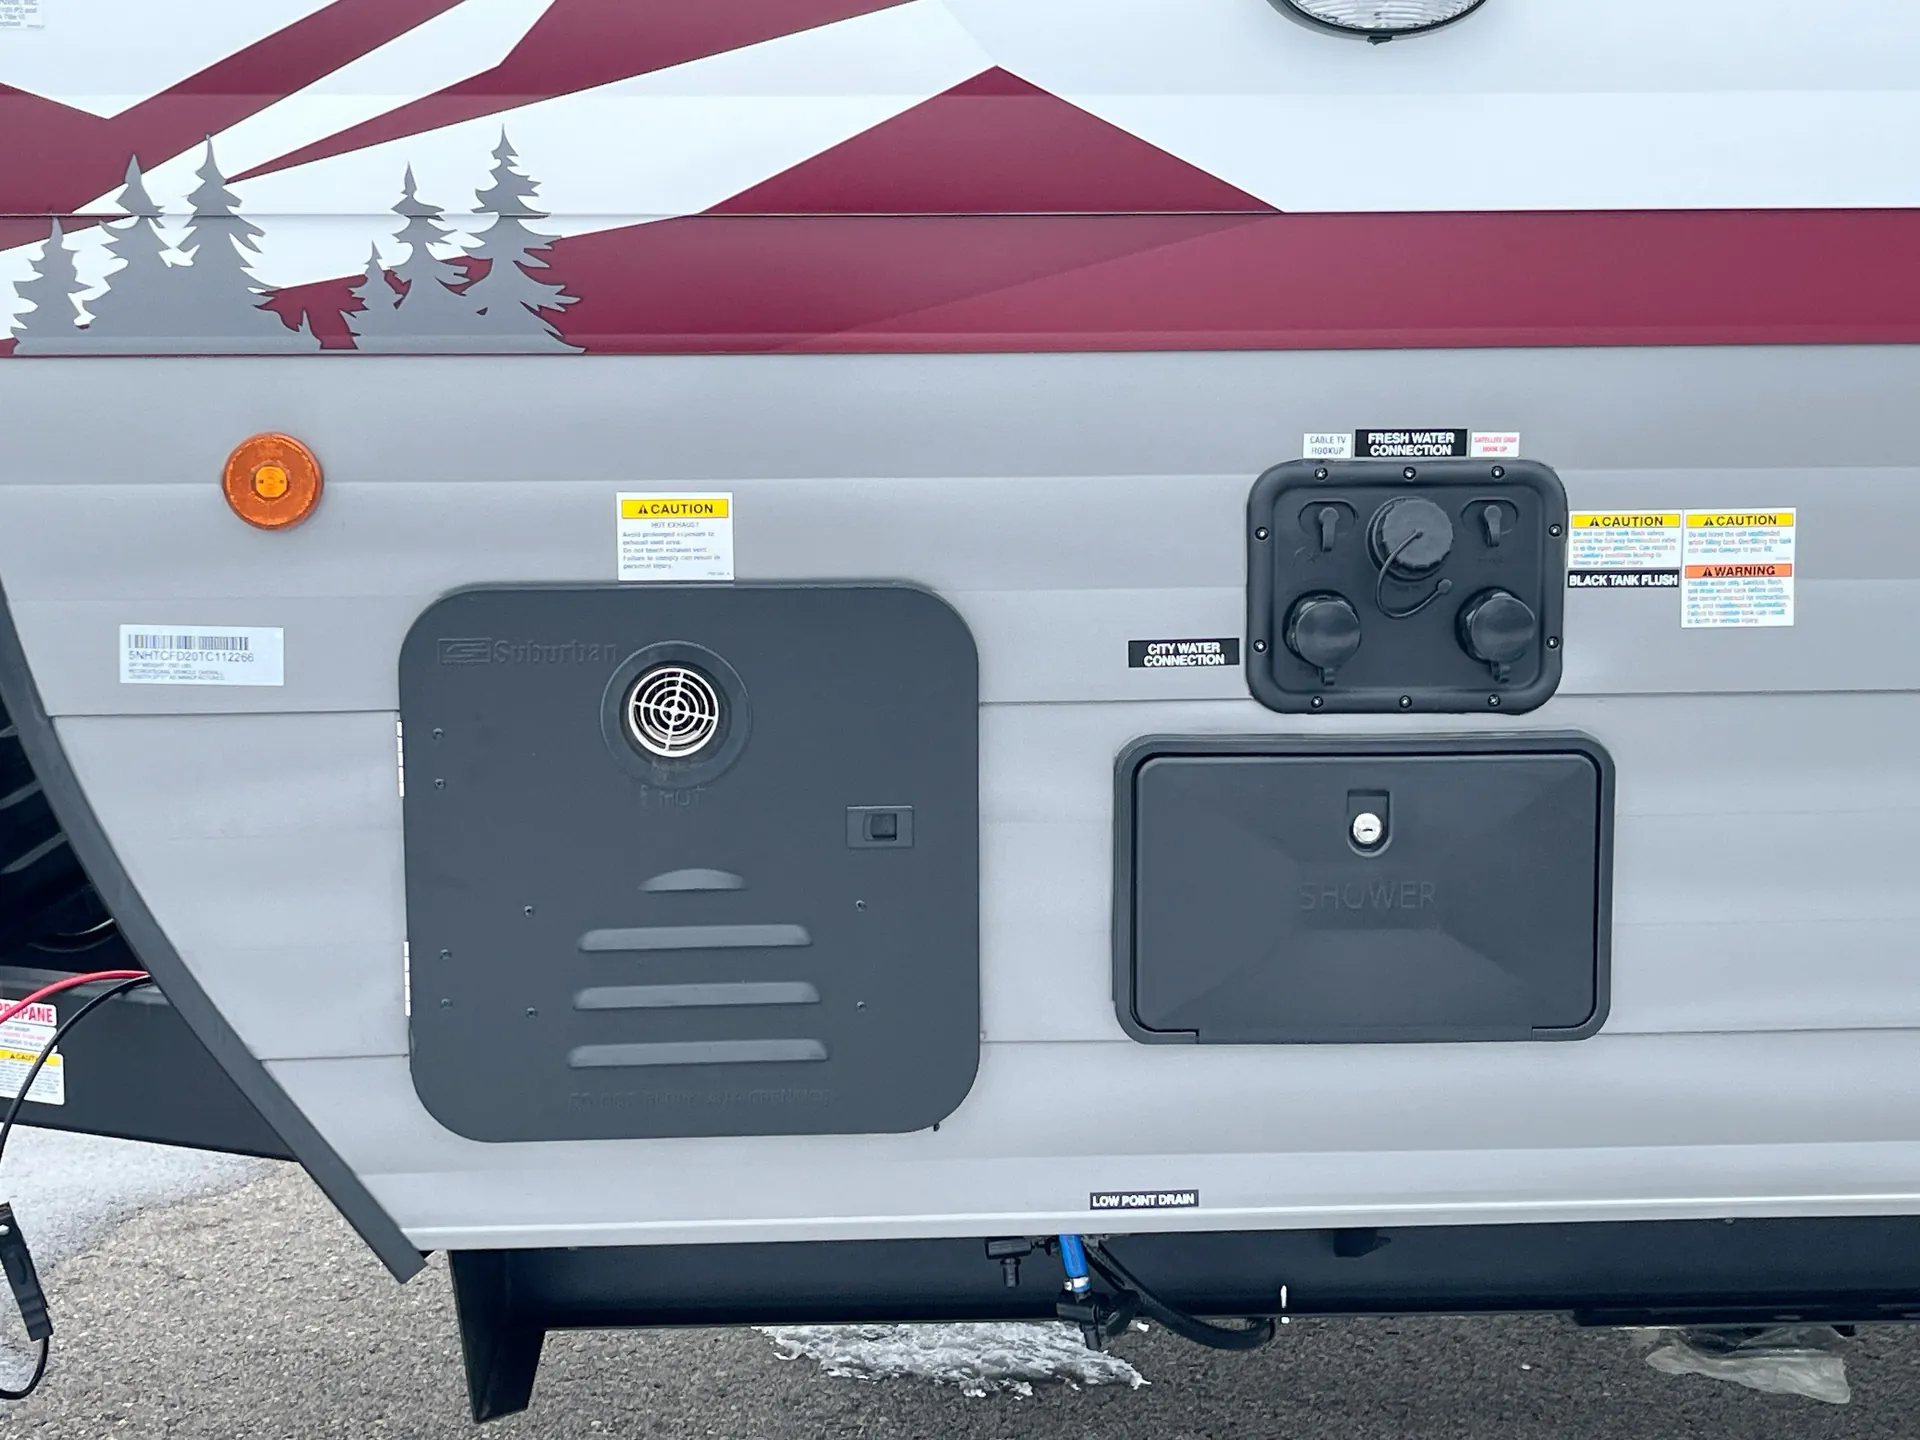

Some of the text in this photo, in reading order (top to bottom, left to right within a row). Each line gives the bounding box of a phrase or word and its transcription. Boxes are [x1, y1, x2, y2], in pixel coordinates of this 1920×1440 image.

[1310, 436, 1346, 444] CABLE TV
[1368, 432, 1455, 444] FRESH WATER
[1311, 447, 1344, 455] HOOKUP
[1370, 445, 1452, 456] CONNECTION
[651, 504, 713, 514] CAUTION
[1602, 517, 1663, 526] CAUTION
[1716, 515, 1777, 526] CAUTION
[1715, 565, 1775, 576] WARNING
[1569, 574, 1678, 586] BLACK TANK FLUSH
[494, 639, 616, 662] Suburban
[1147, 642, 1221, 655] CITY WATER
[1144, 654, 1225, 667] CONNECTION
[1300, 881, 1437, 910] SHOWER
[1092, 1193, 1194, 1207] LOW POINT DRAIN
